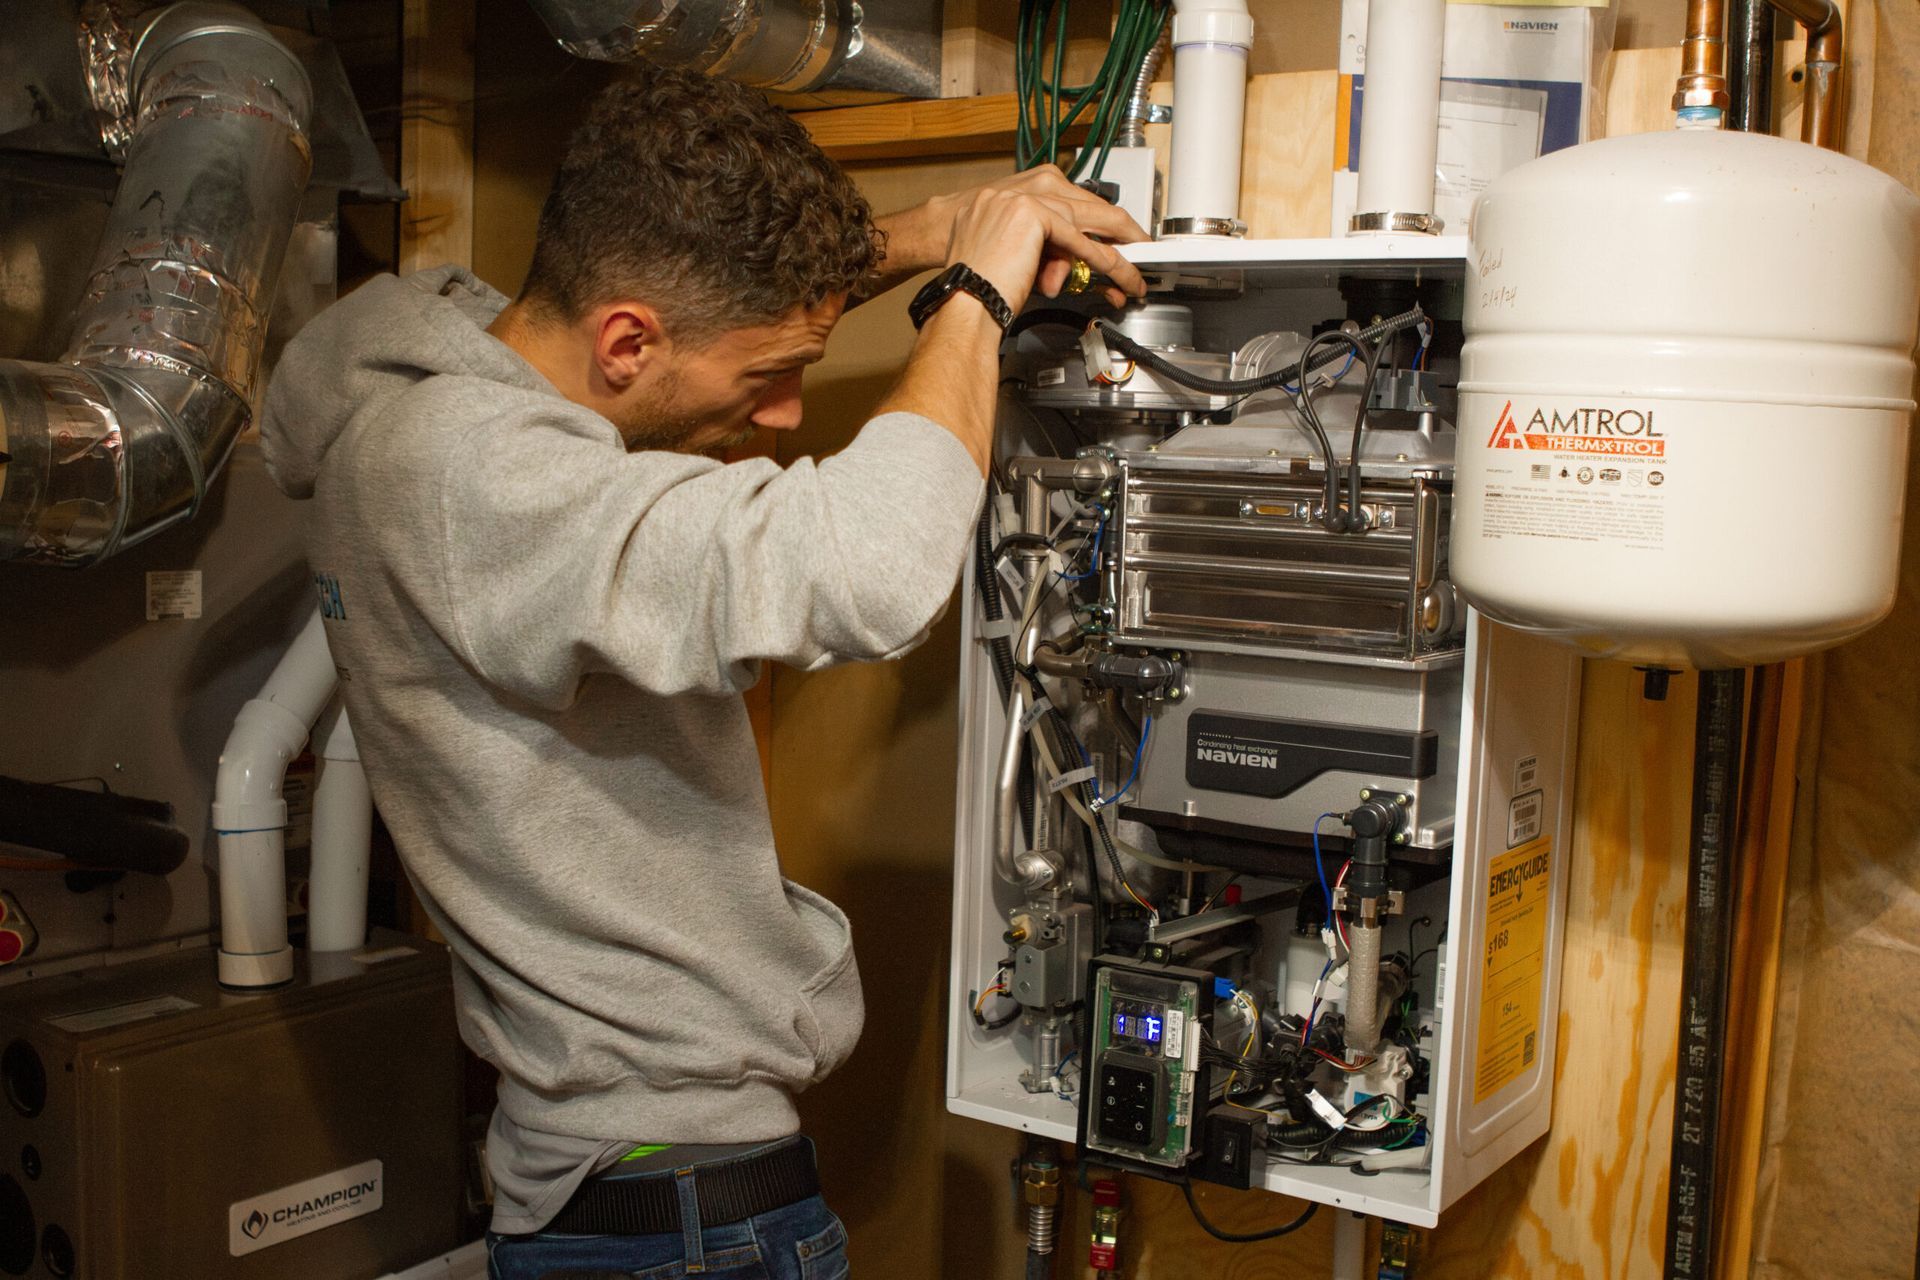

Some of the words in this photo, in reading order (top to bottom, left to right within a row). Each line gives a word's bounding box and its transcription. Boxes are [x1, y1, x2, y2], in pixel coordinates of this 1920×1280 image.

[1526, 407, 1663, 437] AMTROL
[1604, 456, 1645, 465] EXPANSION
[1197, 738, 1232, 751] Condensing
[1233, 743, 1246, 751] heat
[1247, 746, 1279, 755] exchanger
[272, 1181, 375, 1224] CHAMPION
